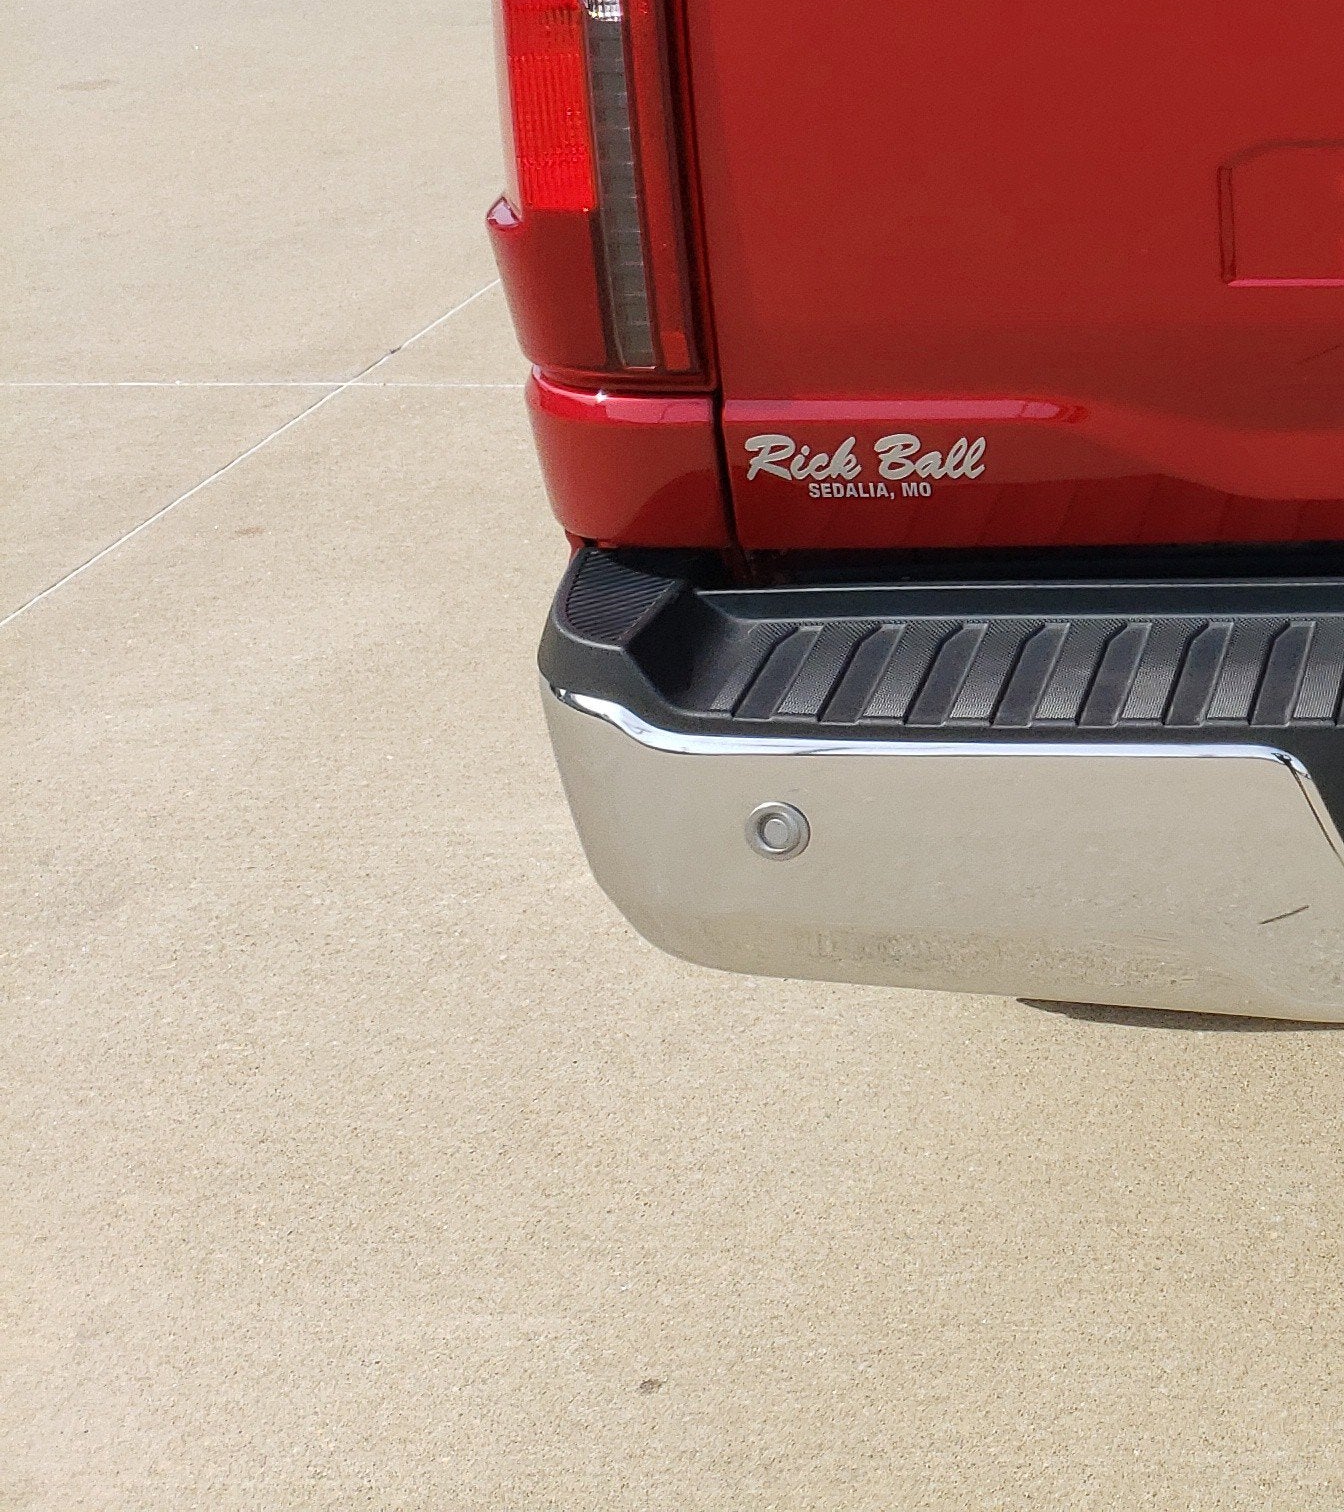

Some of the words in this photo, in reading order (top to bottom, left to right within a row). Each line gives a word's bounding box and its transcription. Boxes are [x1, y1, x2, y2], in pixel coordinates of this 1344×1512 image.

[744, 433, 862, 481] Rick
[873, 433, 986, 481] Ball
[808, 482, 895, 499] SEDALIA,
[902, 481, 932, 497] MO
